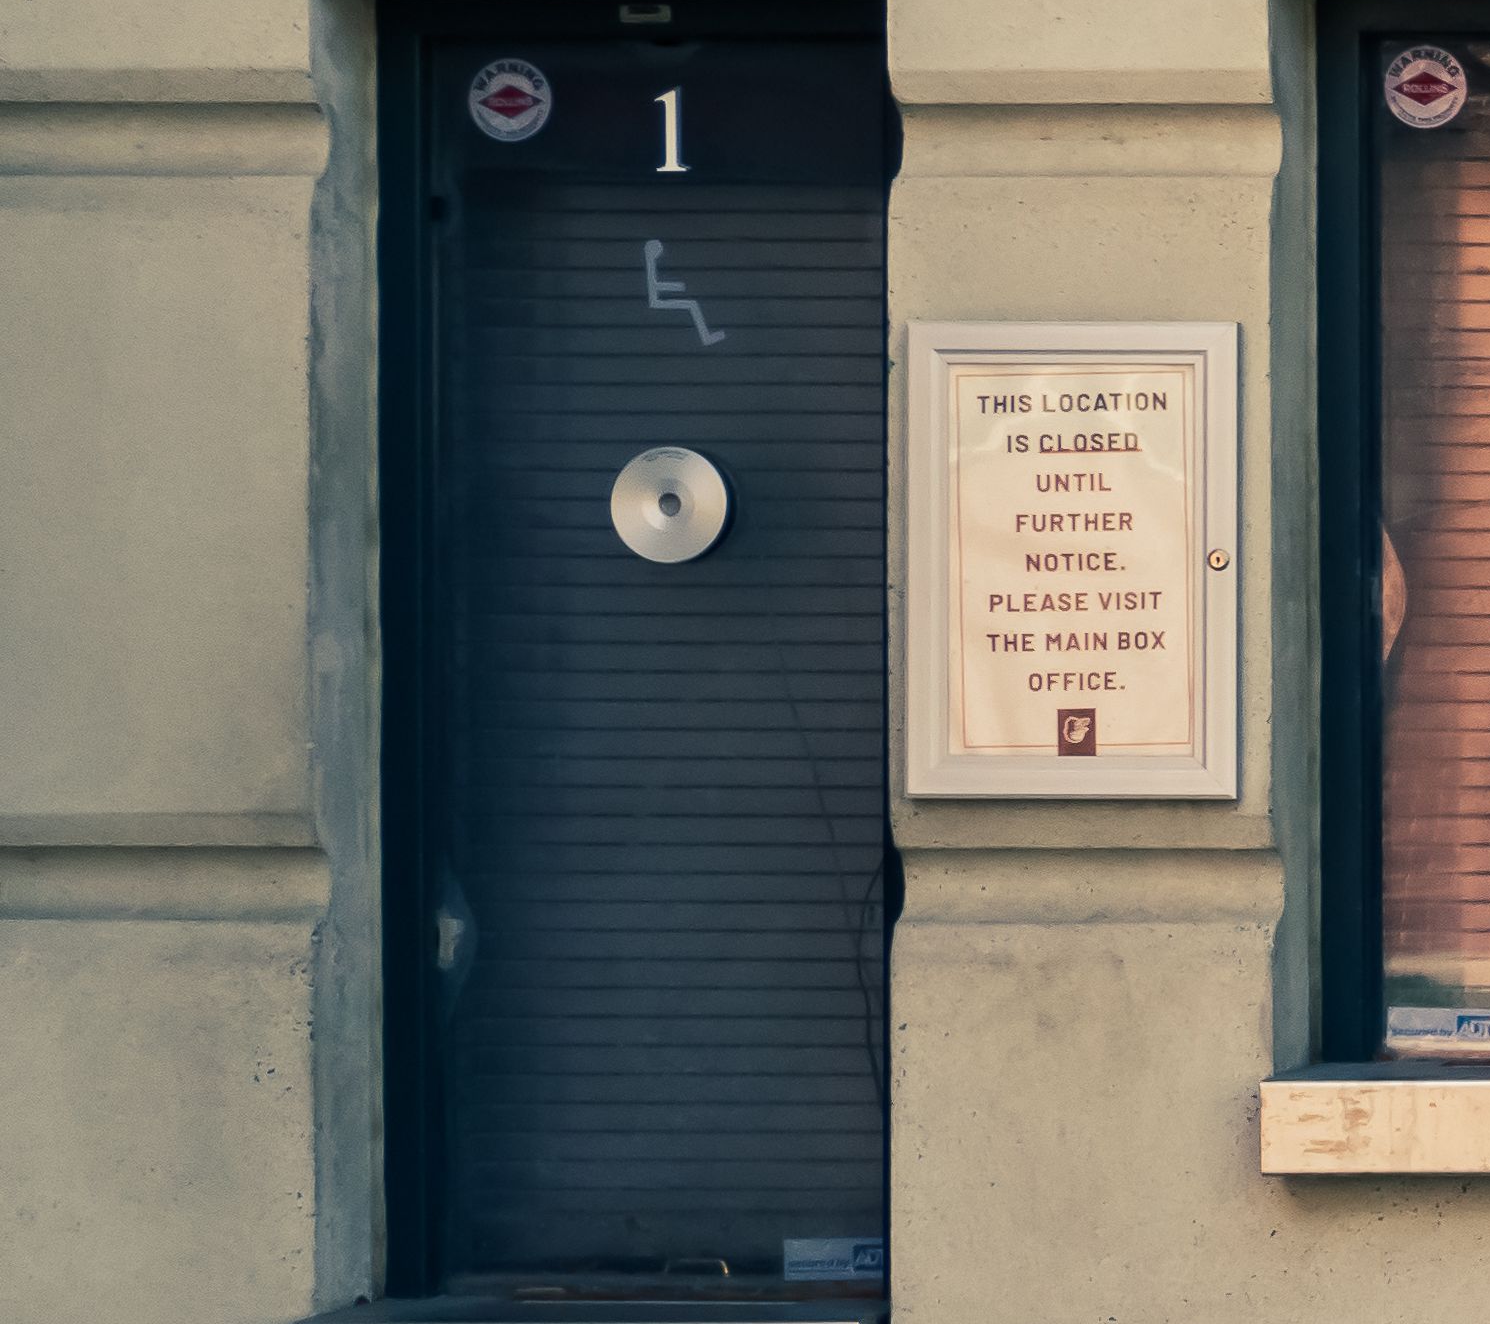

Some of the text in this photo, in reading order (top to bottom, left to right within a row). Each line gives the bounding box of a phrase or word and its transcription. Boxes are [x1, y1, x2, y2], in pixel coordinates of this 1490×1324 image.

[1389, 49, 1460, 77] WARNING
[473, 63, 544, 91] WARNING
[655, 87, 689, 173] 1
[976, 392, 1167, 414] THIS LOCATION
[1006, 432, 1143, 454] IS CLOSED
[1036, 472, 1112, 493] UNTIL
[1015, 512, 1133, 533] FURTHER
[1025, 552, 1126, 573] NOTICE.
[989, 591, 1163, 613] PLEASE VISIT
[985, 630, 1166, 653] THE MAIN BOX
[1028, 671, 1126, 692] OFFICE.
